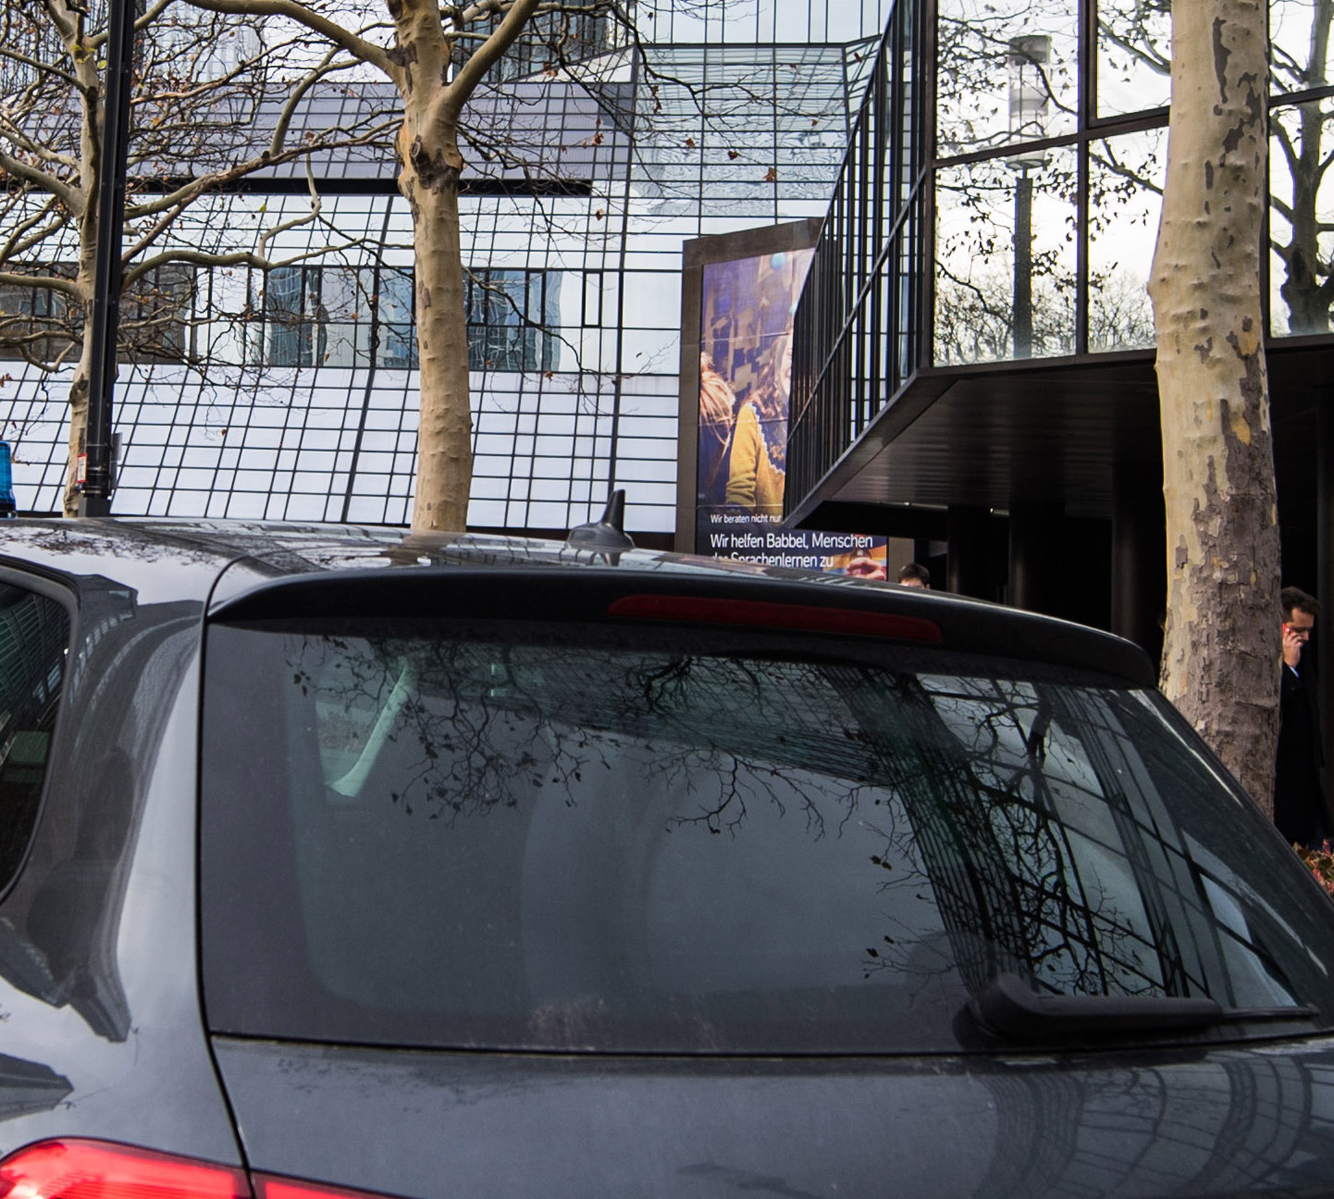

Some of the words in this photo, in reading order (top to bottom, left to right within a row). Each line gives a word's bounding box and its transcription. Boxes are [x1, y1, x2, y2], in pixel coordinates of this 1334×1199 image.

[710, 513, 723, 524] Wir
[724, 514, 750, 524] beraten
[751, 513, 768, 523] nicht
[710, 533, 729, 548] Wir
[730, 532, 764, 548] helfen
[766, 533, 809, 550] Babbel,
[811, 533, 873, 548] Menschen
[819, 556, 834, 567] zu
